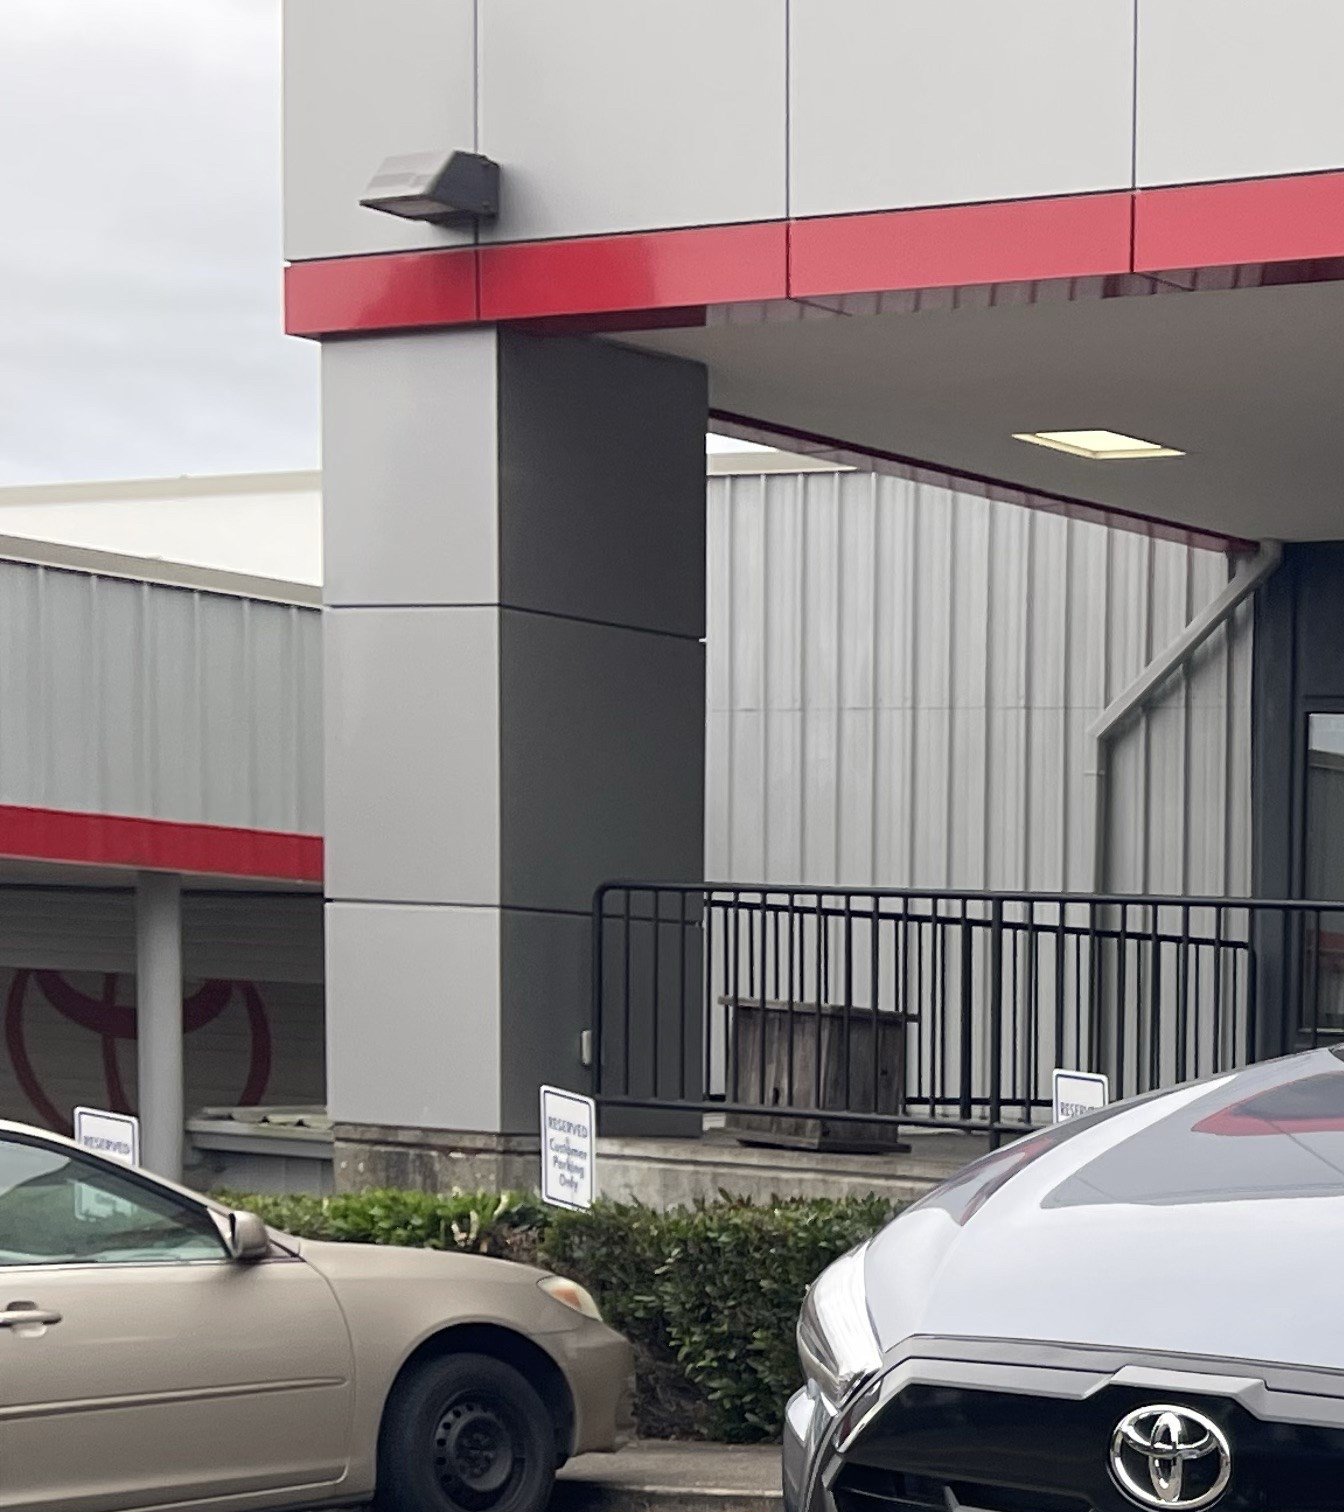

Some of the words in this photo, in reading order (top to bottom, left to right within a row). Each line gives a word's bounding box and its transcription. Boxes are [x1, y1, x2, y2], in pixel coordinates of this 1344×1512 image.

[548, 1116, 588, 1139] RESERVED
[549, 1137, 588, 1159] Customer
[552, 1155, 584, 1179] Parking
[558, 1173, 578, 1192] Only
